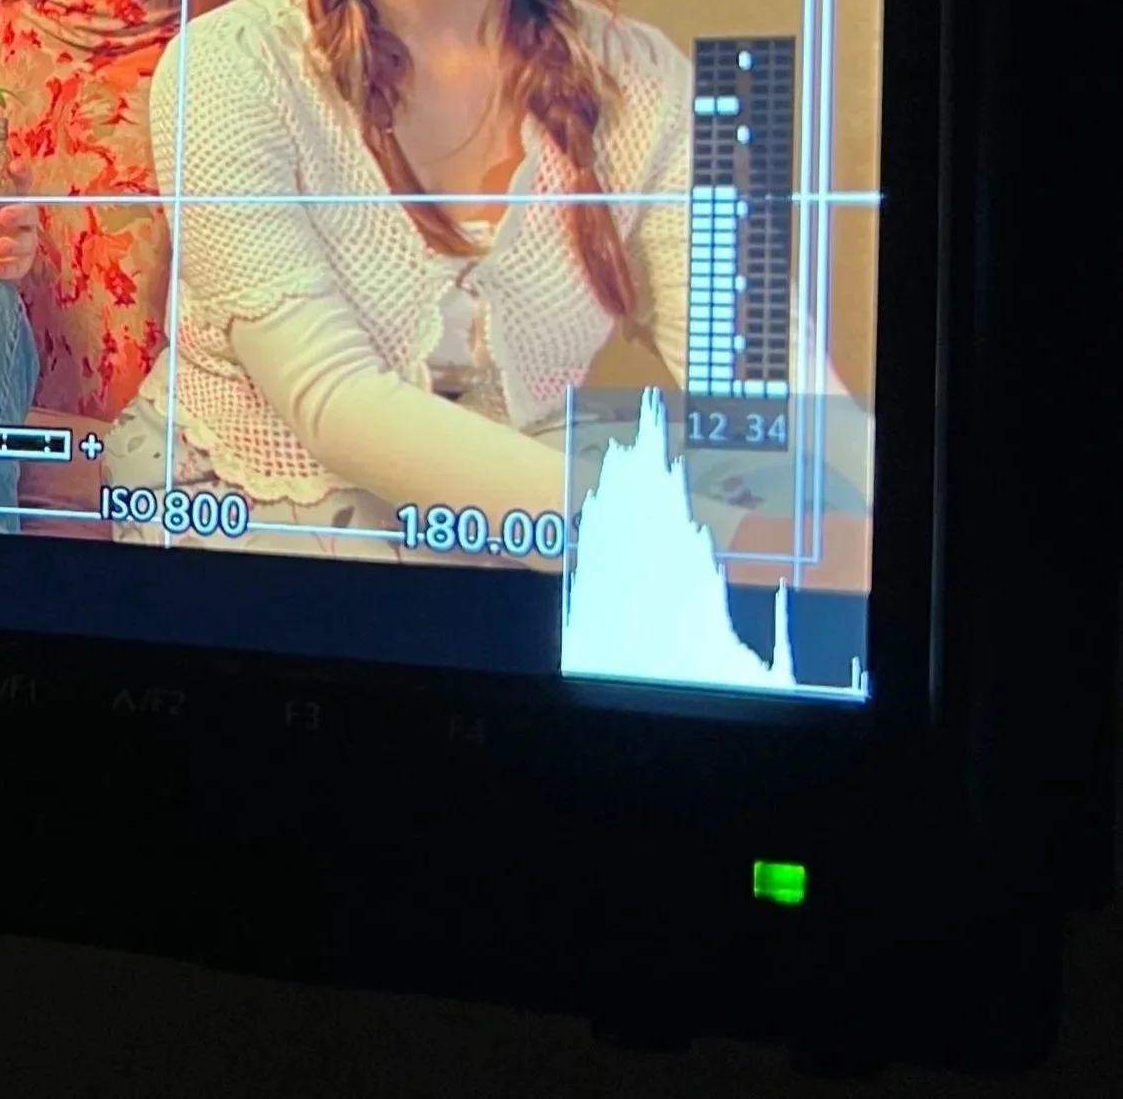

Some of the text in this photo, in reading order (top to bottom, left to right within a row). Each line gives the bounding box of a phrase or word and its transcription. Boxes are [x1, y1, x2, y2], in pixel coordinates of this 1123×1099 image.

[687, 410, 788, 443] 12 34
[101, 487, 249, 538] ISO 800
[284, 699, 321, 731] F3
